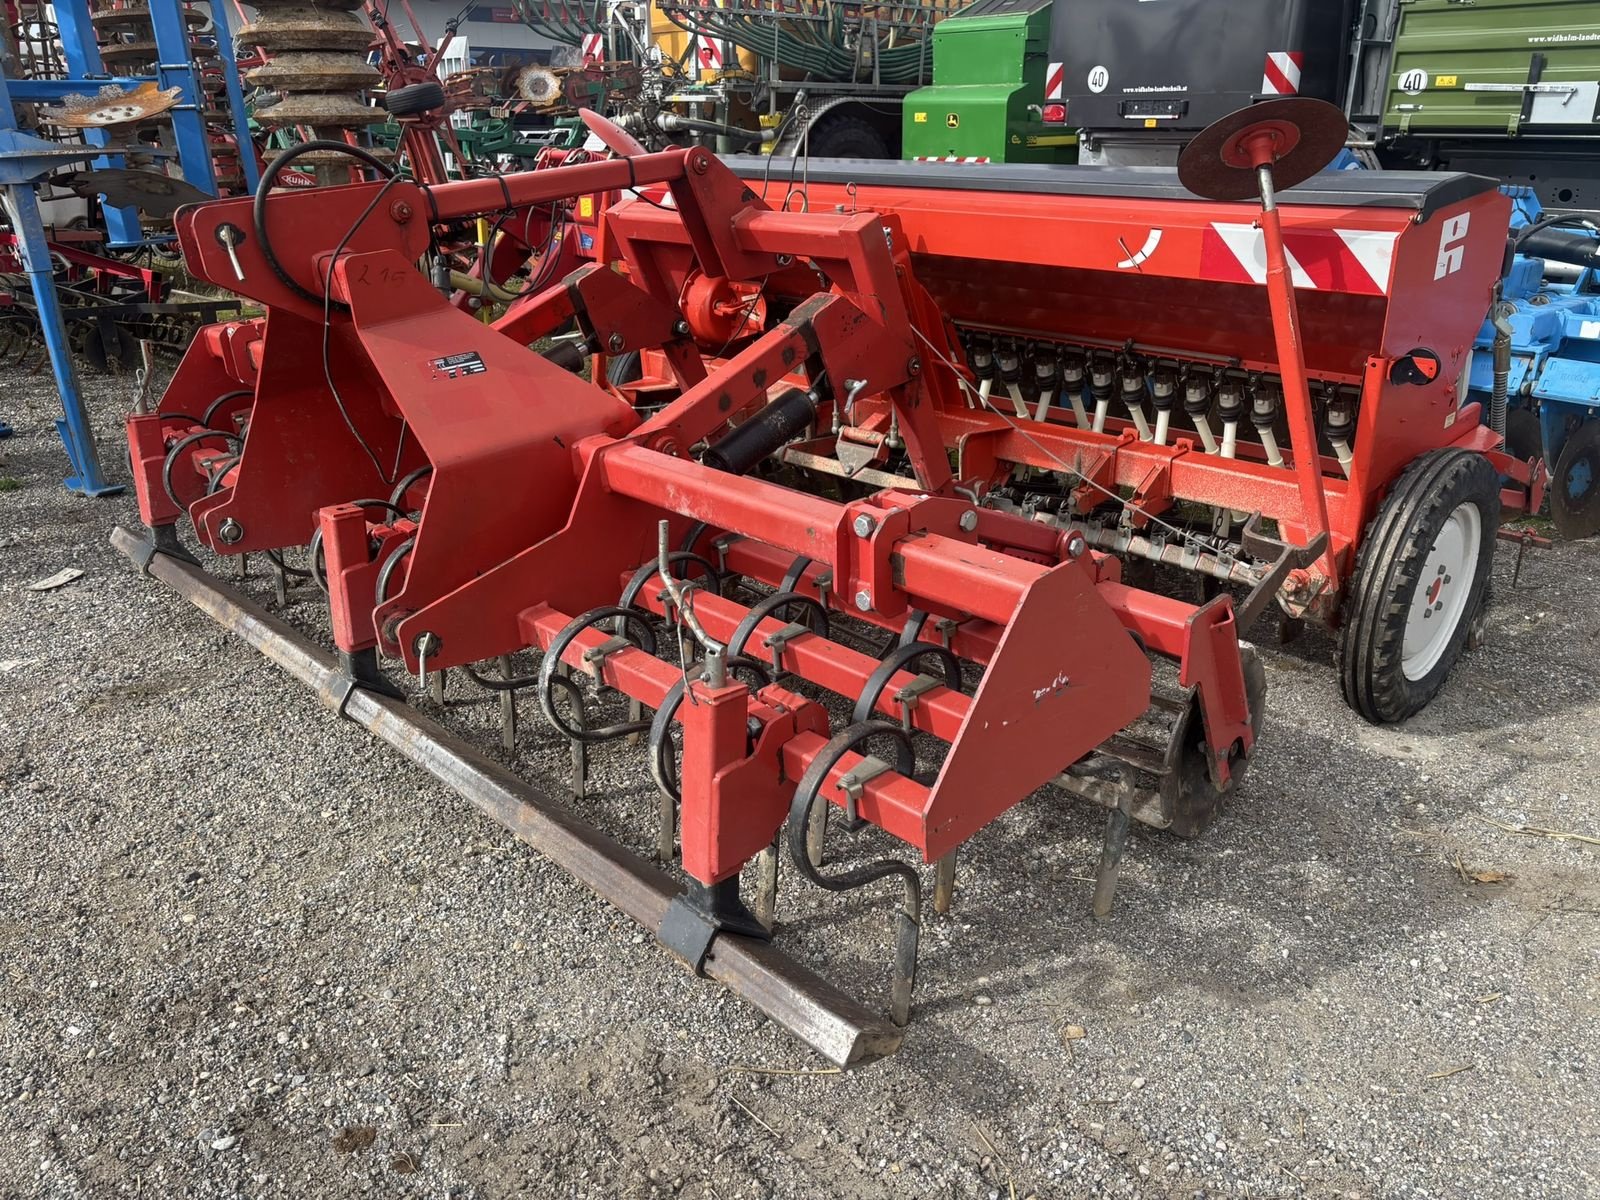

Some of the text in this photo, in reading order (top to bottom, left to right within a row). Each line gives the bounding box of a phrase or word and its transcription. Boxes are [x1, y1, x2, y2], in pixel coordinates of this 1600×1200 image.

[1092, 71, 1104, 87] 40
[1403, 73, 1421, 91] 40
[286, 176, 310, 186] KUHN
